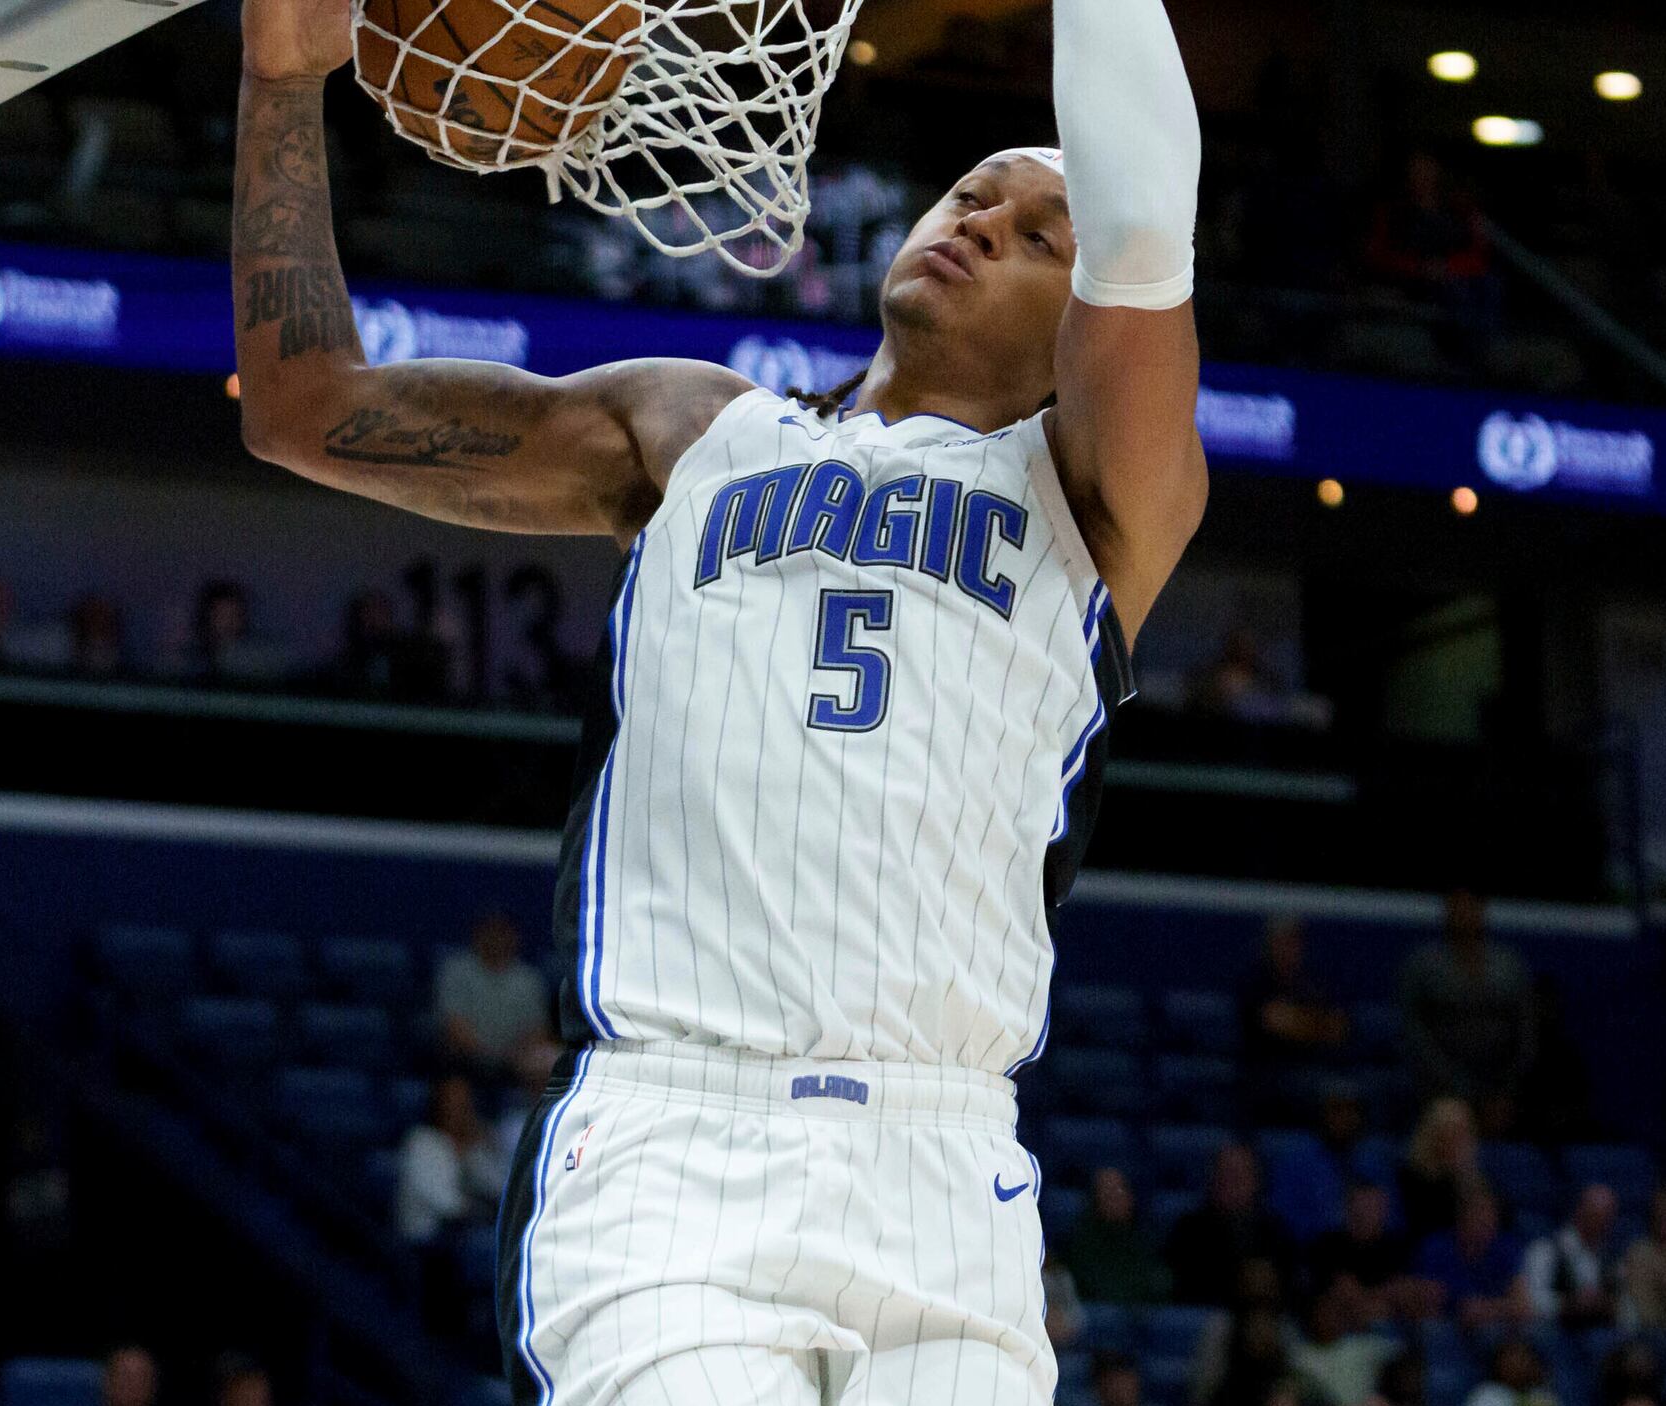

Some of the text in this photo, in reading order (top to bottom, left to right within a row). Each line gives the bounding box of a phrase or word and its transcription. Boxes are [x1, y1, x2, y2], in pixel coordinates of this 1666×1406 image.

[693, 459, 1030, 622] MAGIC
[806, 588, 893, 734] 5
[791, 1073, 870, 1106] ORLANDO
